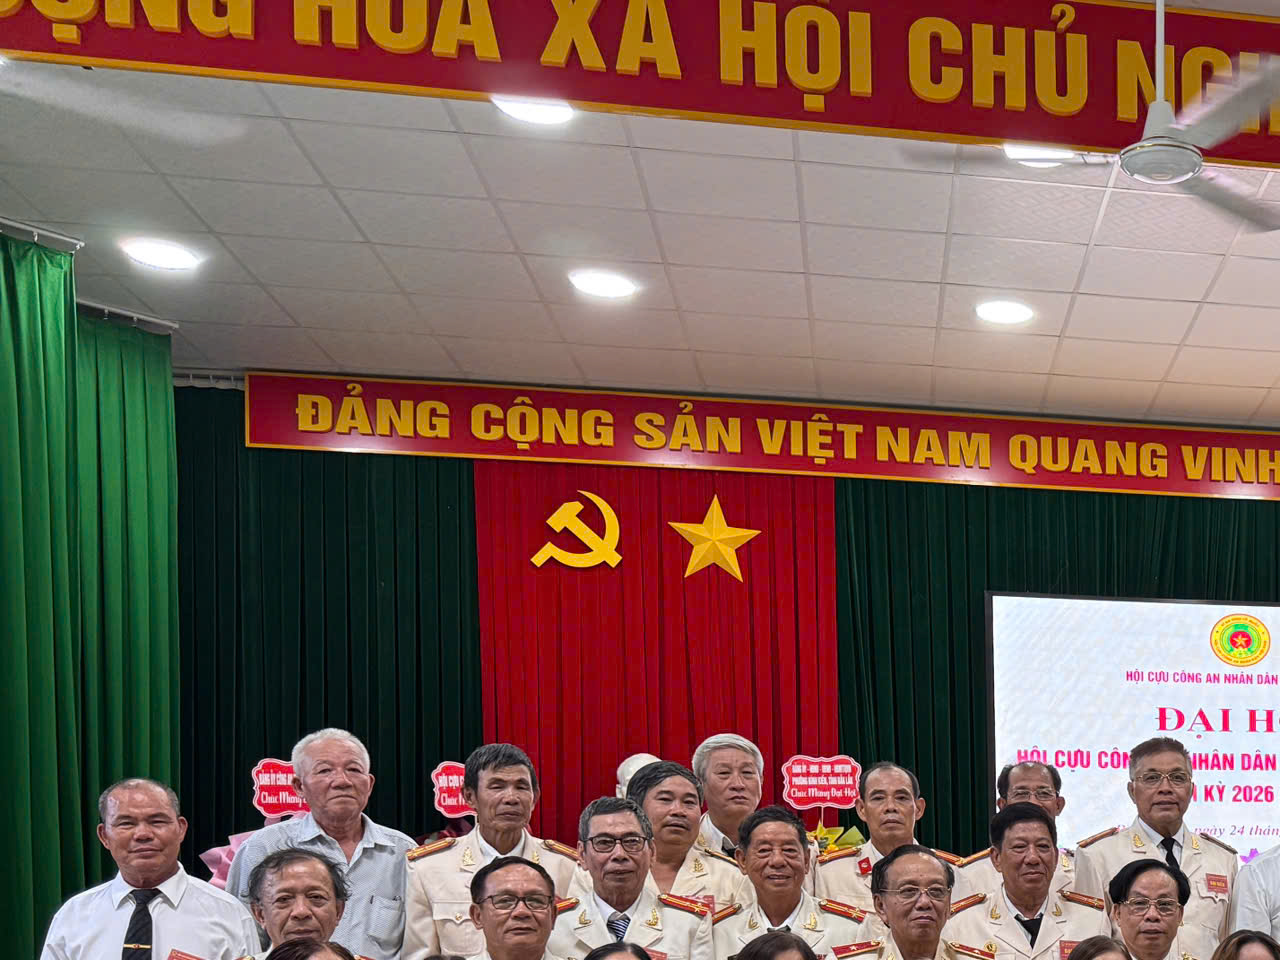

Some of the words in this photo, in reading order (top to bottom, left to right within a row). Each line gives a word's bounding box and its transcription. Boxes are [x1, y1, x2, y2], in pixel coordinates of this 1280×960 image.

[720, 0, 872, 112] HỘI
[909, 0, 1094, 116] CHỦ
[296, 378, 456, 444] ĐẢNG
[471, 397, 614, 449] CỘNG
[633, 402, 741, 459] SẢN
[757, 414, 863, 464] VIỆT
[877, 427, 996, 474] NAM
[1004, 435, 1167, 483] QUANG
[1126, 671, 1143, 681] HỘI
[1148, 671, 1168, 682] CỰU
[1173, 672, 1201, 683] CÔNG
[1206, 673, 1220, 683] AN
[1224, 674, 1253, 684] NHÂN
[1257, 675, 1278, 685] DÂN
[1154, 707, 1232, 740] ĐẠI
[1052, 749, 1090, 775] CỰU
[1241, 754, 1276, 770] DÂN
[1205, 785, 1225, 801] KỲ
[1232, 786, 1274, 802] 2026
